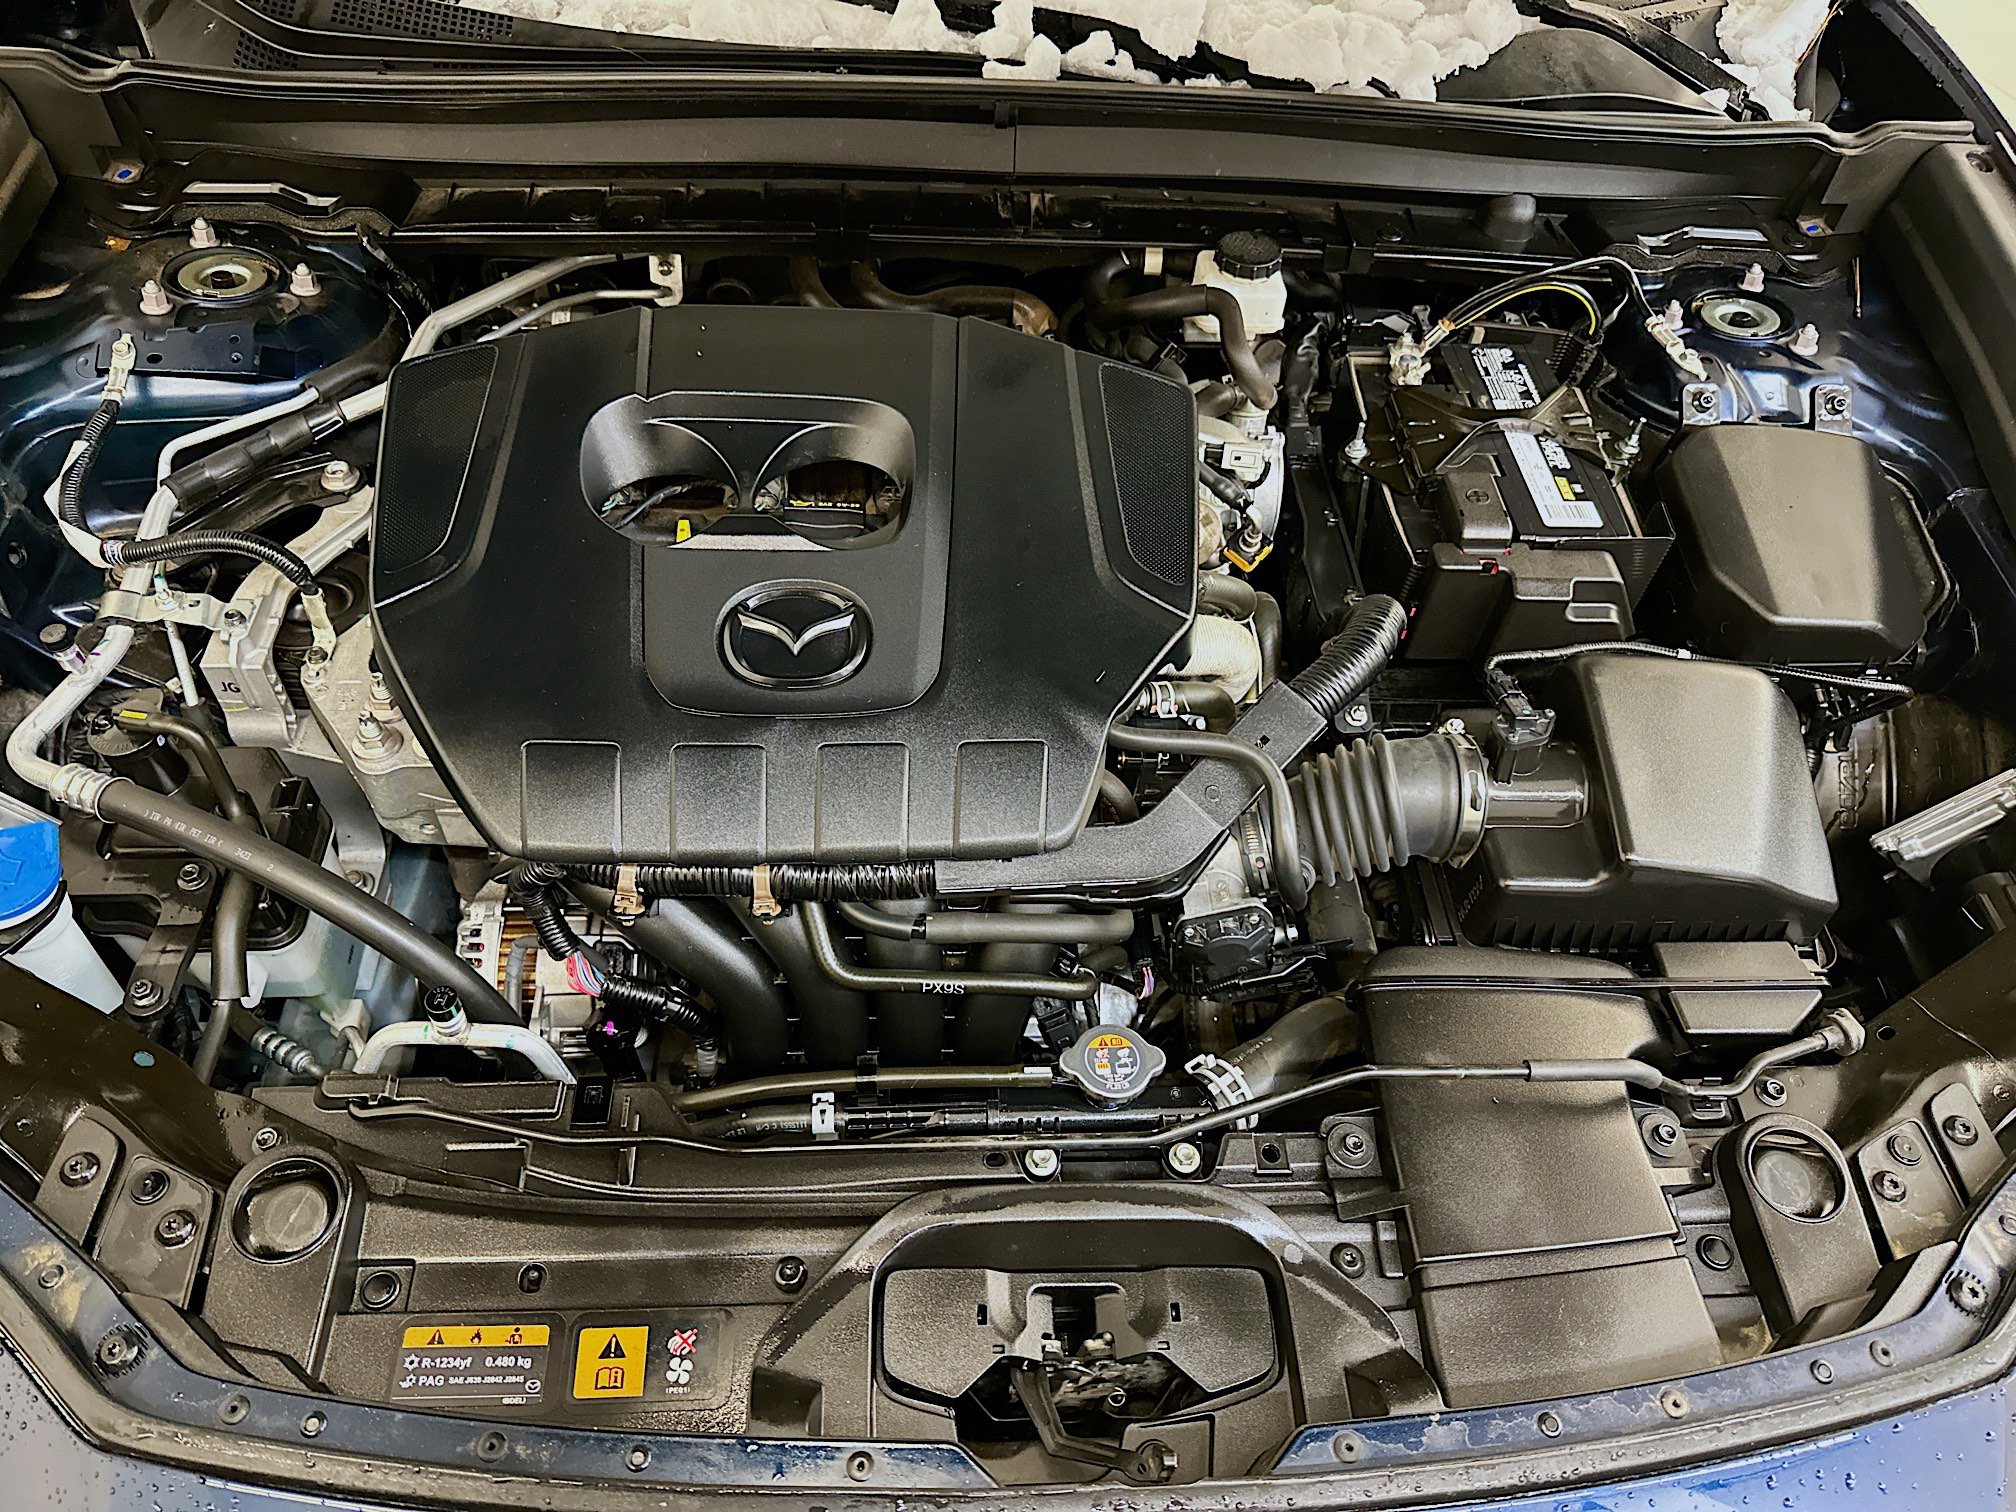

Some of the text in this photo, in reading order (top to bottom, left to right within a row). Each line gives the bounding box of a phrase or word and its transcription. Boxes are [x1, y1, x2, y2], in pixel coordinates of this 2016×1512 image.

[221, 681, 241, 693] JG
[922, 980, 965, 995] PX9S
[421, 1355, 532, 1371] R-1234yf 0.480 kg
[417, 1374, 445, 1387] PAG
[448, 1376, 465, 1385] SAE
